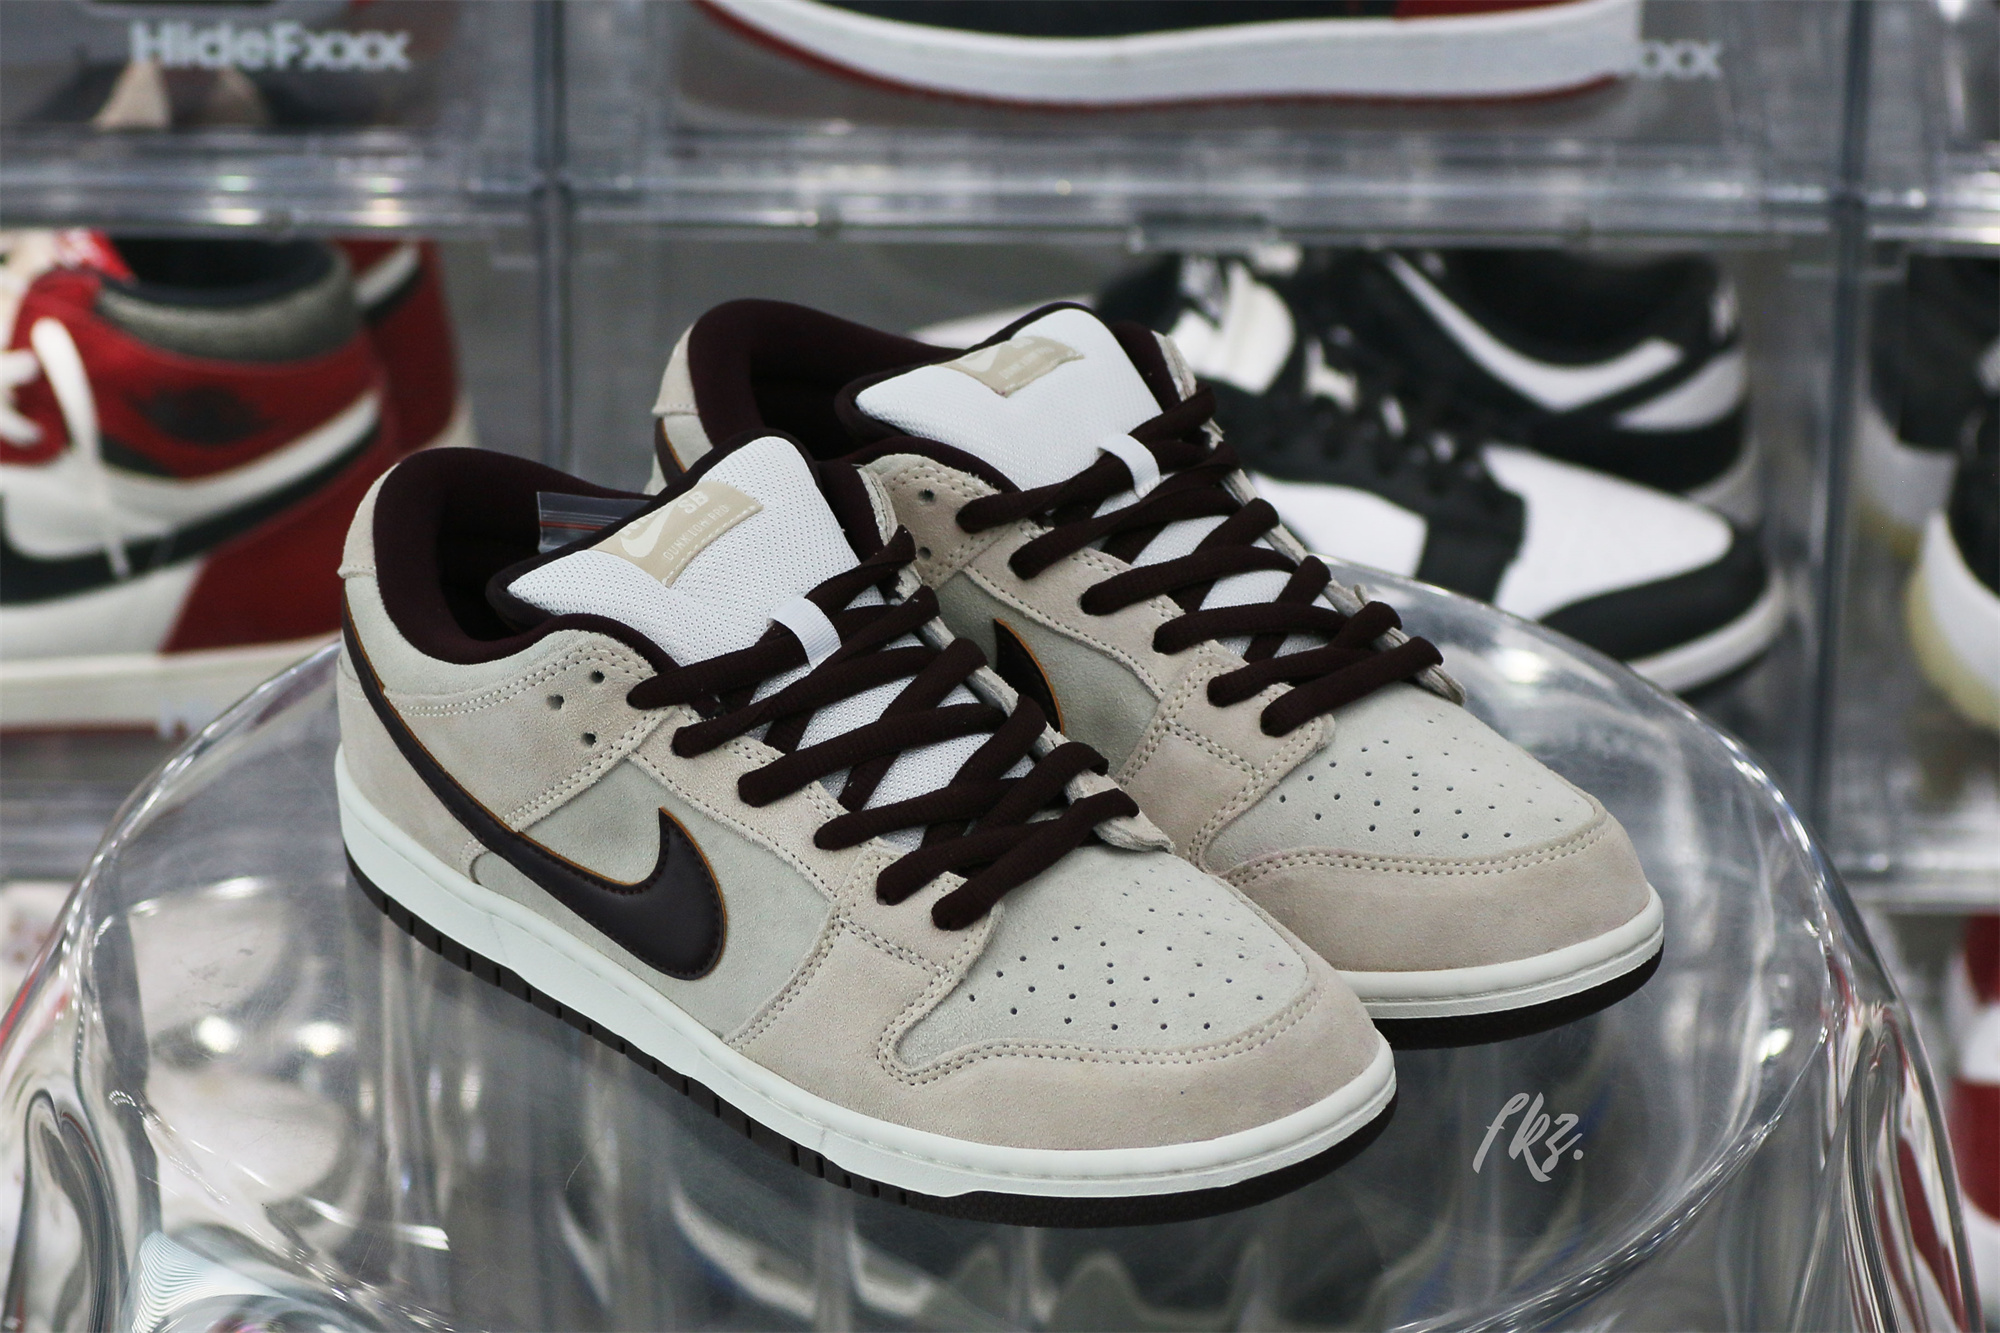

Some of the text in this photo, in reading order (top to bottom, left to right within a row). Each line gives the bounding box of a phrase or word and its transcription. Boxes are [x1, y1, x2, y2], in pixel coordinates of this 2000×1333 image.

[677, 491, 709, 514] SB
[663, 533, 692, 561] DUNK
[707, 504, 730, 521] PRO
